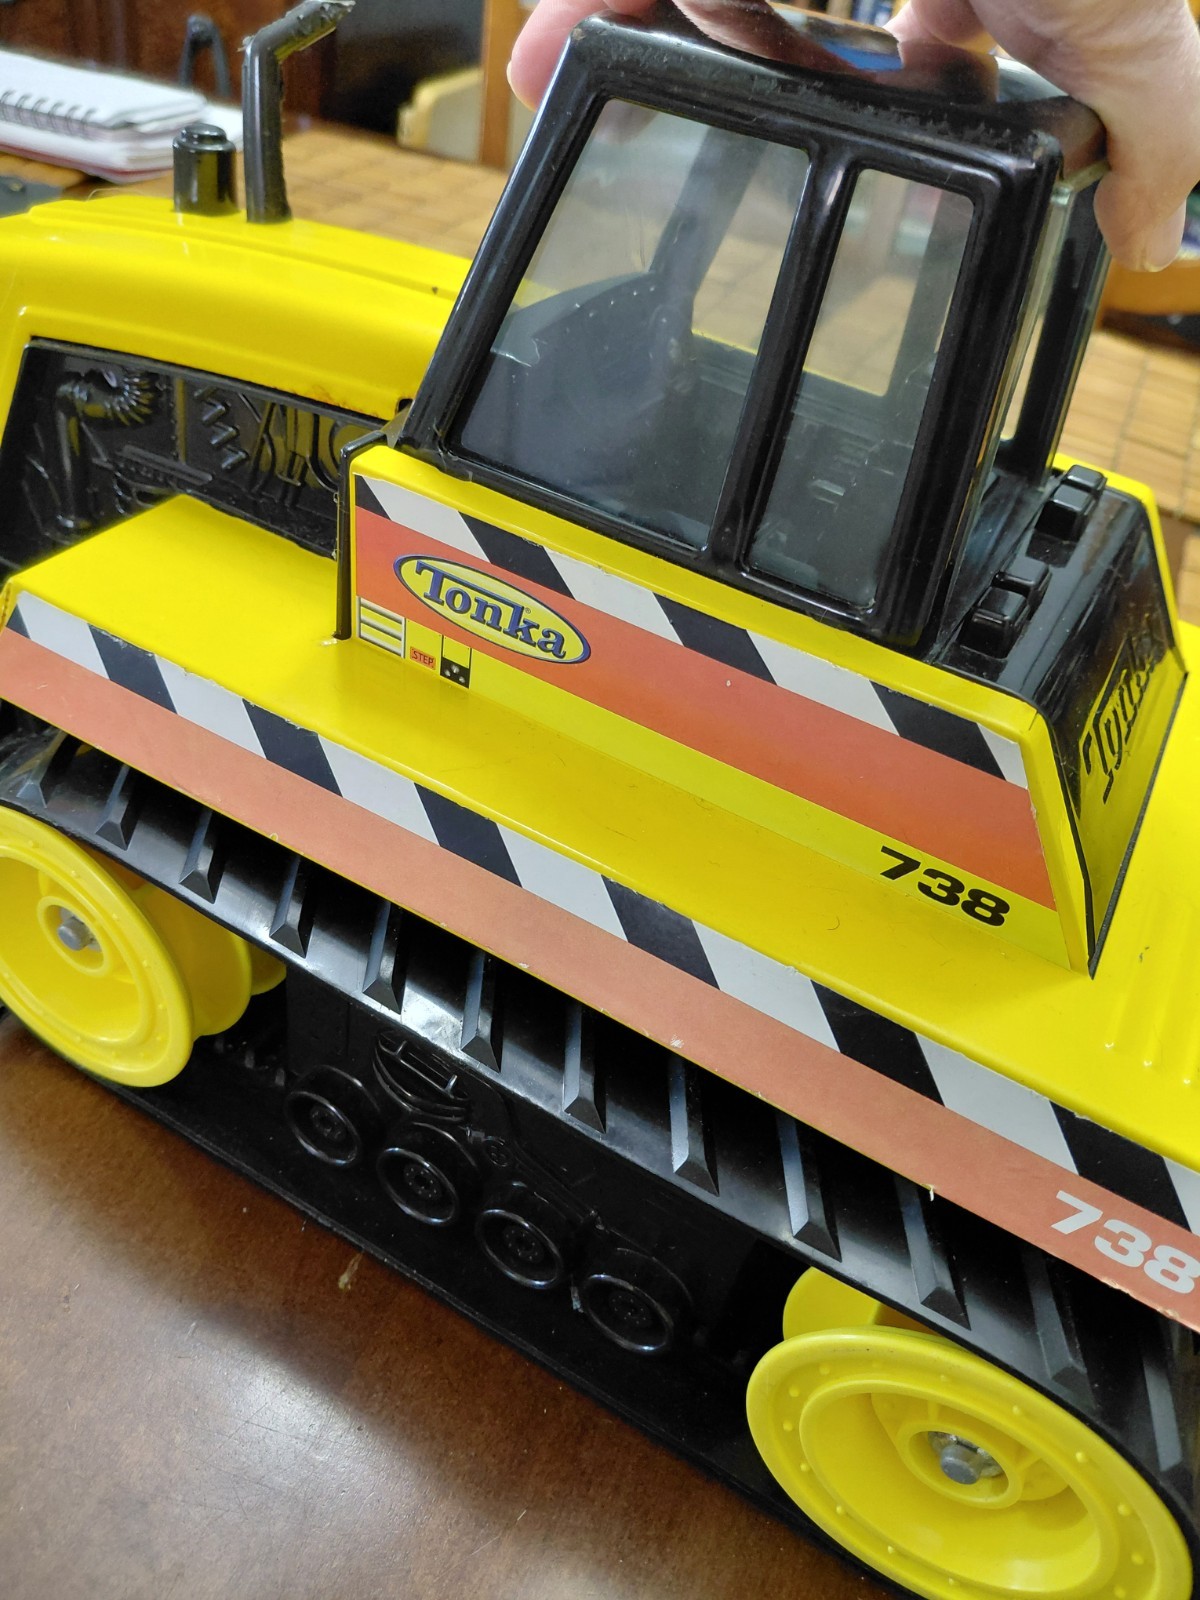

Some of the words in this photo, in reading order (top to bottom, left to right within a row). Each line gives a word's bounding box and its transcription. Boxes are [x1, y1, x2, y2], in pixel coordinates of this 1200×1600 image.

[415, 560, 566, 658] Tonka
[411, 650, 434, 666] STEP
[880, 845, 1011, 927] 738
[1050, 1190, 1200, 1294] 738
